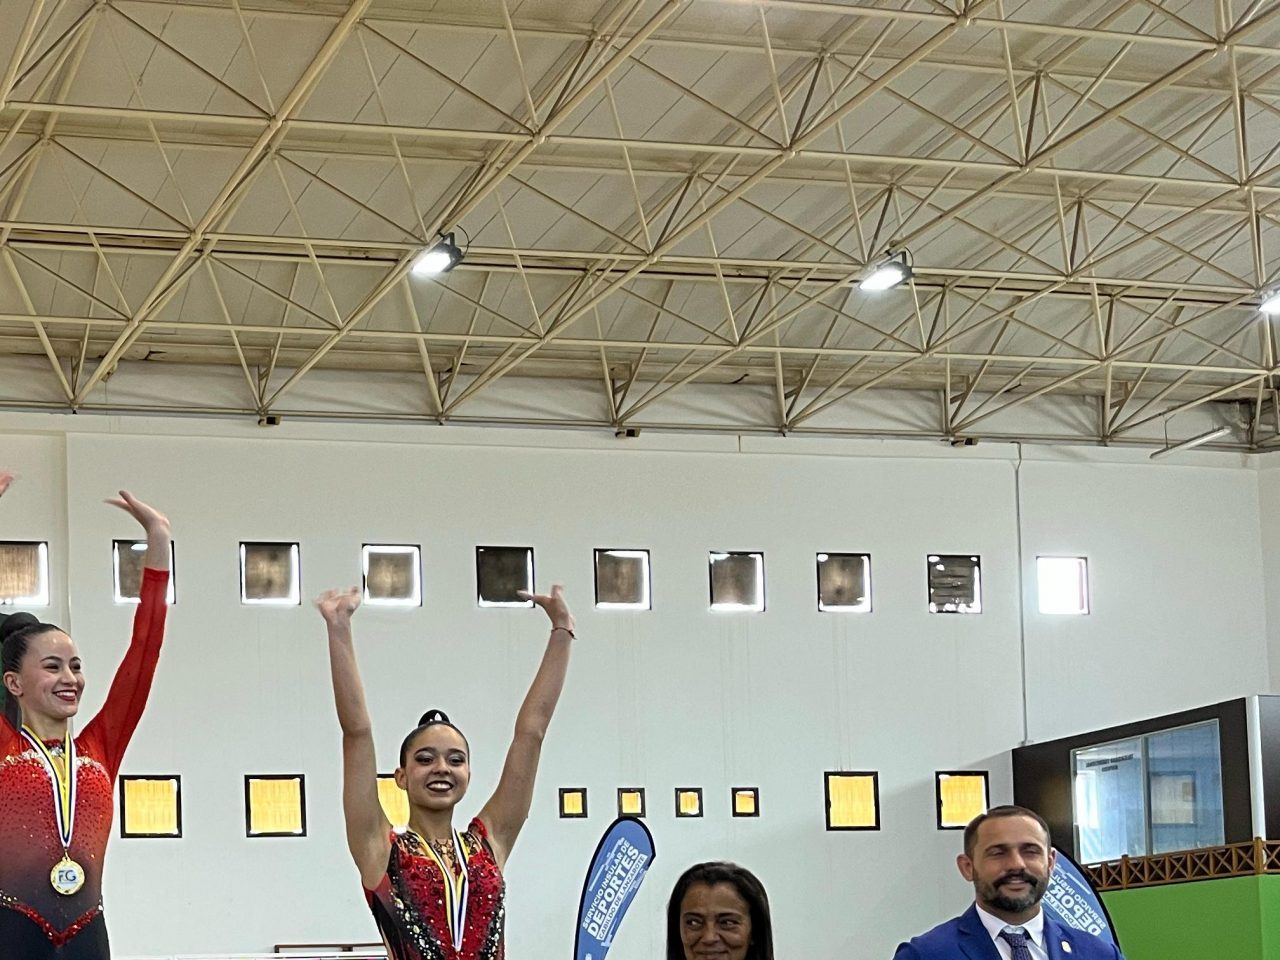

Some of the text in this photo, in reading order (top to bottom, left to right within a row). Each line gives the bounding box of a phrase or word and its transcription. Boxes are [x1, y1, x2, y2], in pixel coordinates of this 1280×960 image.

[582, 888, 604, 930] SERVICIO
[602, 852, 624, 890] INSULAR
[587, 845, 639, 938] DEPORTES
